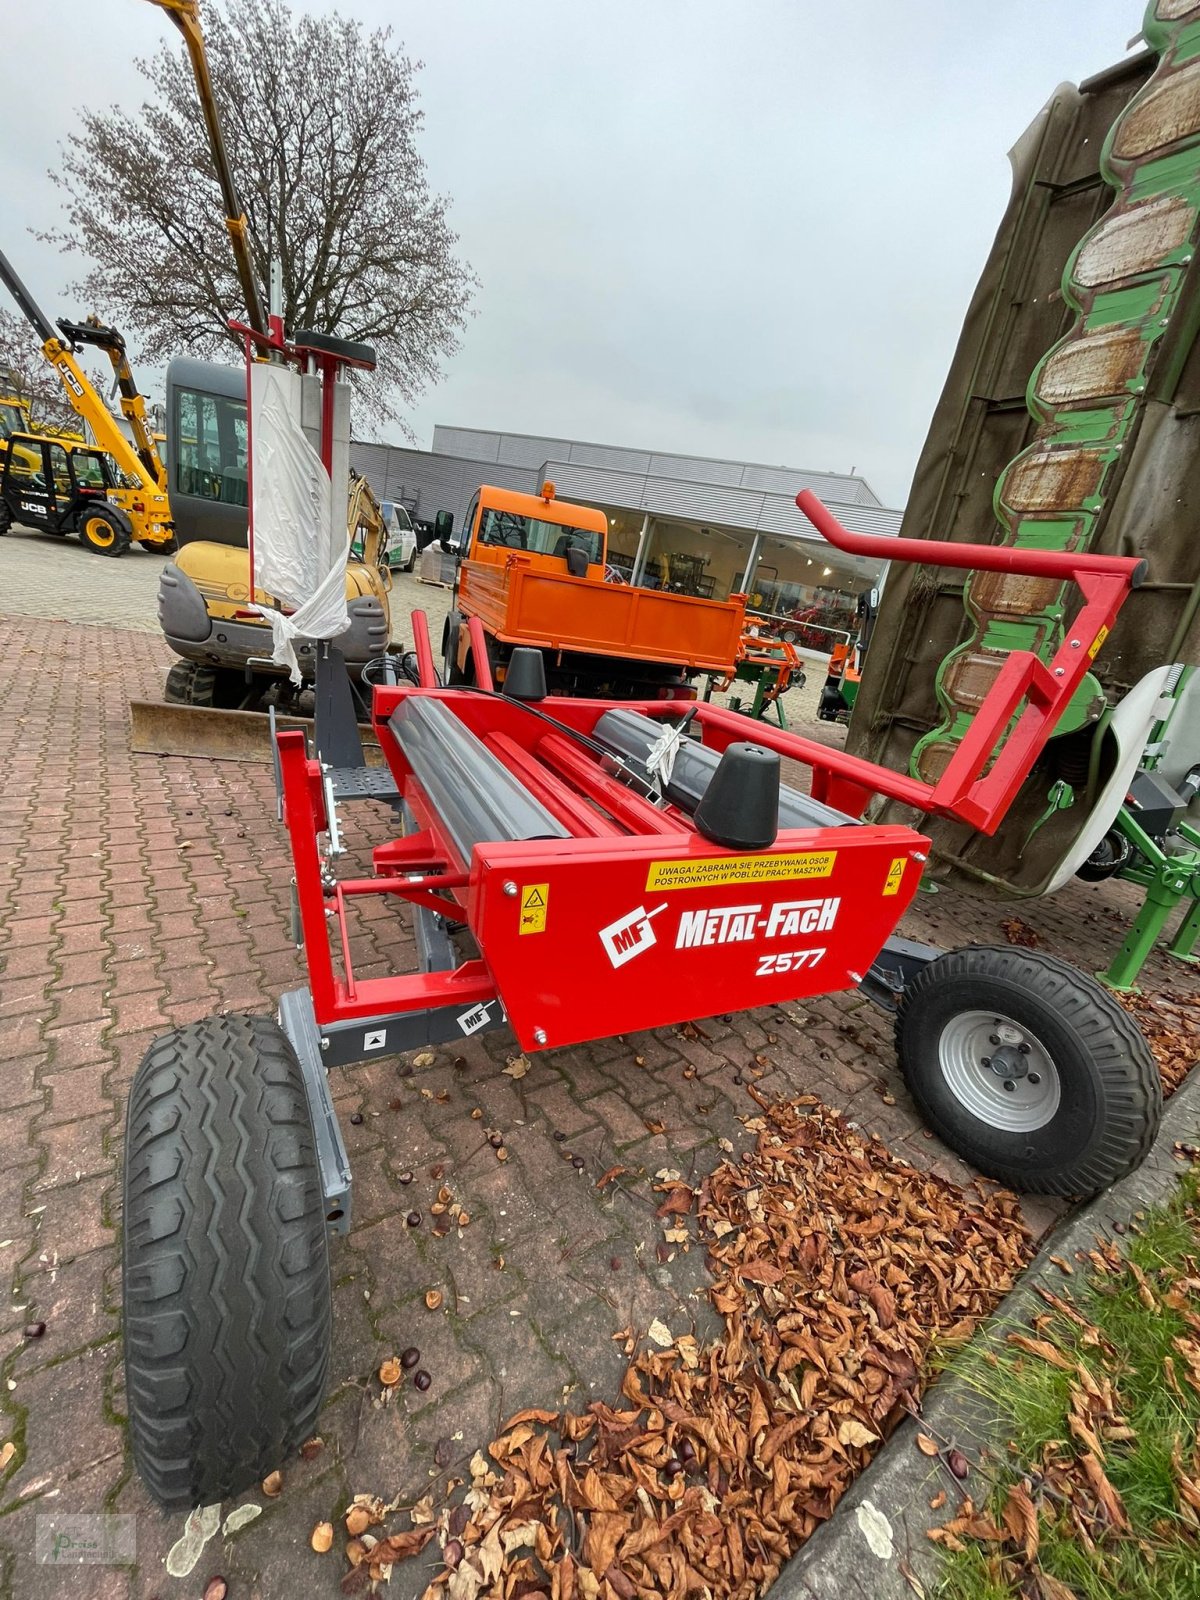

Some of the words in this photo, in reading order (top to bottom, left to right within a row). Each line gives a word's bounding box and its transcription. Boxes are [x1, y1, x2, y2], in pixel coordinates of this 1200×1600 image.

[57, 360, 85, 398] JCB
[20, 500, 47, 515] JCB
[654, 874, 719, 886] POSTRONNYCH
[729, 870, 765, 879] POBLIŻU
[765, 868, 791, 877] PRACY
[792, 866, 827, 875] MASZYNY
[658, 866, 695, 876] UWAGA!
[696, 863, 738, 873] ZABRANIA
[753, 859, 808, 868] PRZEBYWANIA
[808, 856, 830, 865] OSÓB
[610, 922, 646, 955] MF
[755, 948, 827, 976] Z577
[463, 1010, 484, 1029] MF
